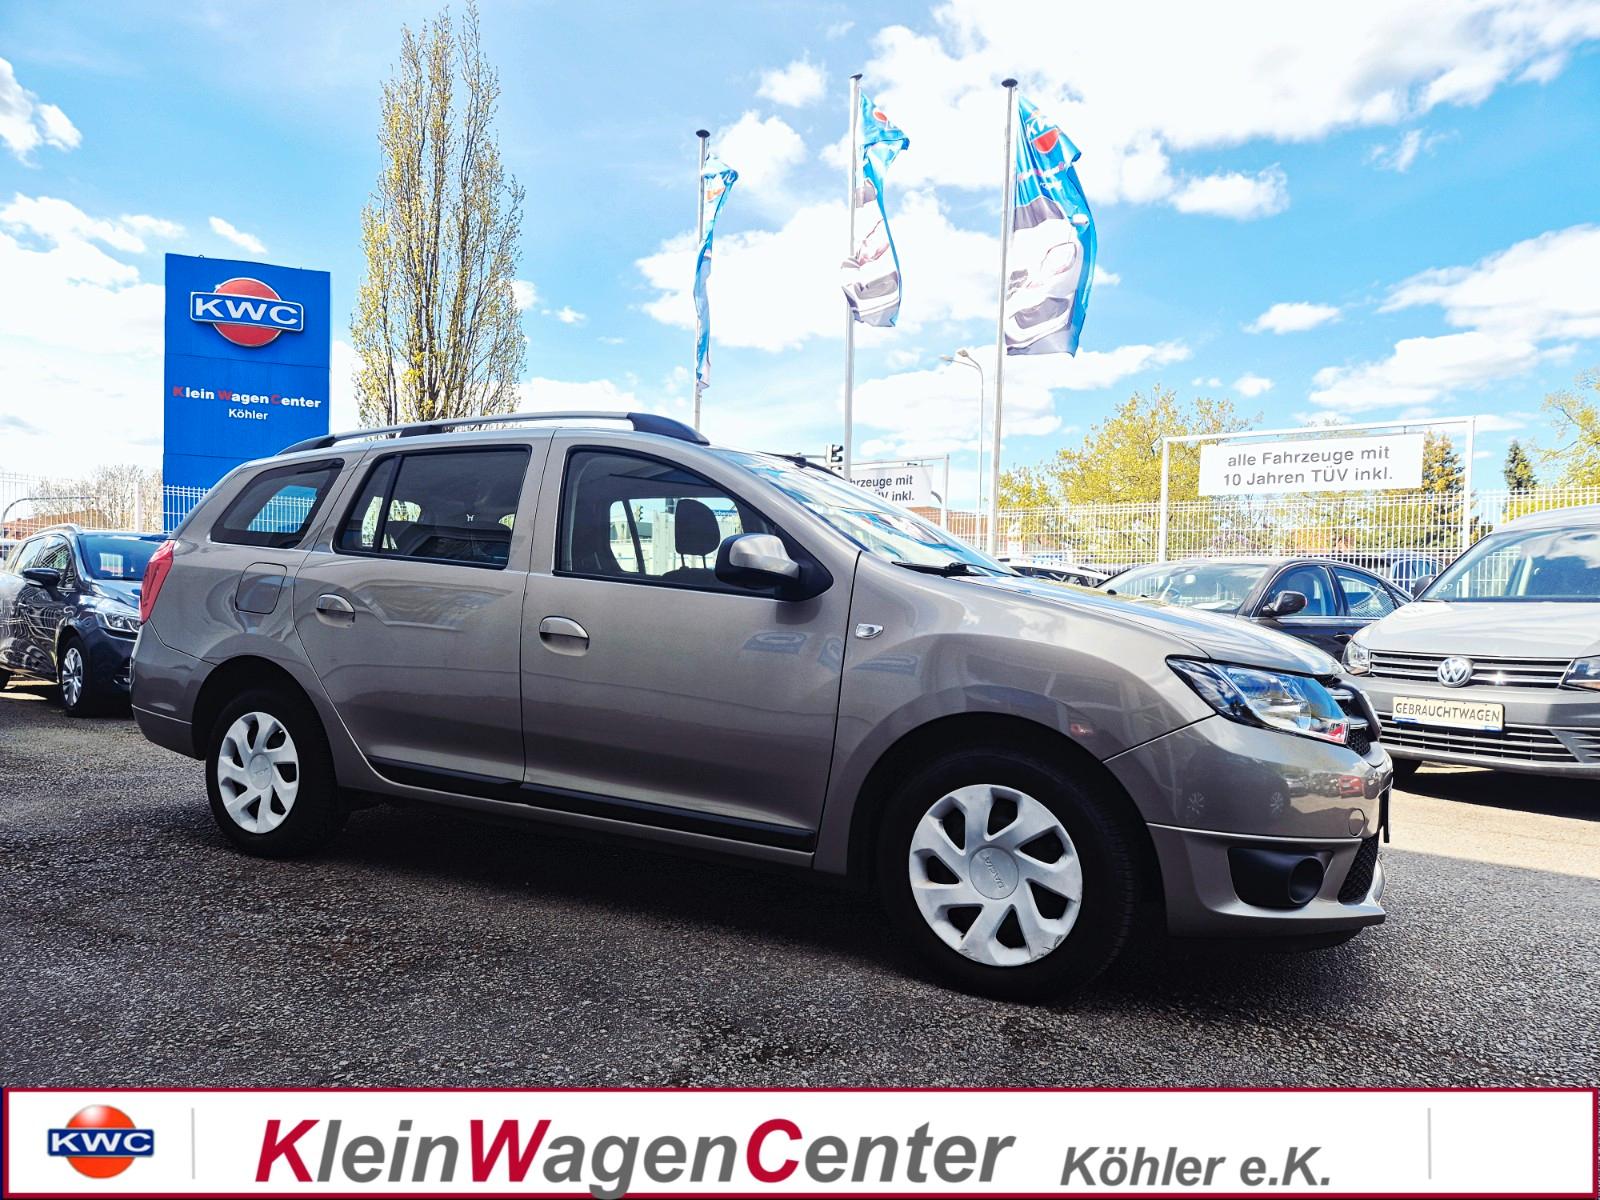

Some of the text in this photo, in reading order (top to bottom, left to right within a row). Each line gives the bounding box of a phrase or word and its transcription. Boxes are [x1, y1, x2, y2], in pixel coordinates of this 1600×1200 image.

[195, 298, 298, 325] KWC
[173, 386, 321, 408] Klein Wagen Center
[228, 408, 268, 420] Köhler
[1228, 445, 1390, 467] alle Fahrzeuge mit
[895, 474, 913, 486] mit
[1224, 465, 1393, 486] 10 Jahren TÜV inkl.
[891, 490, 915, 501] inkl.
[1395, 702, 1501, 722] GEBRAUCHTWAGEN
